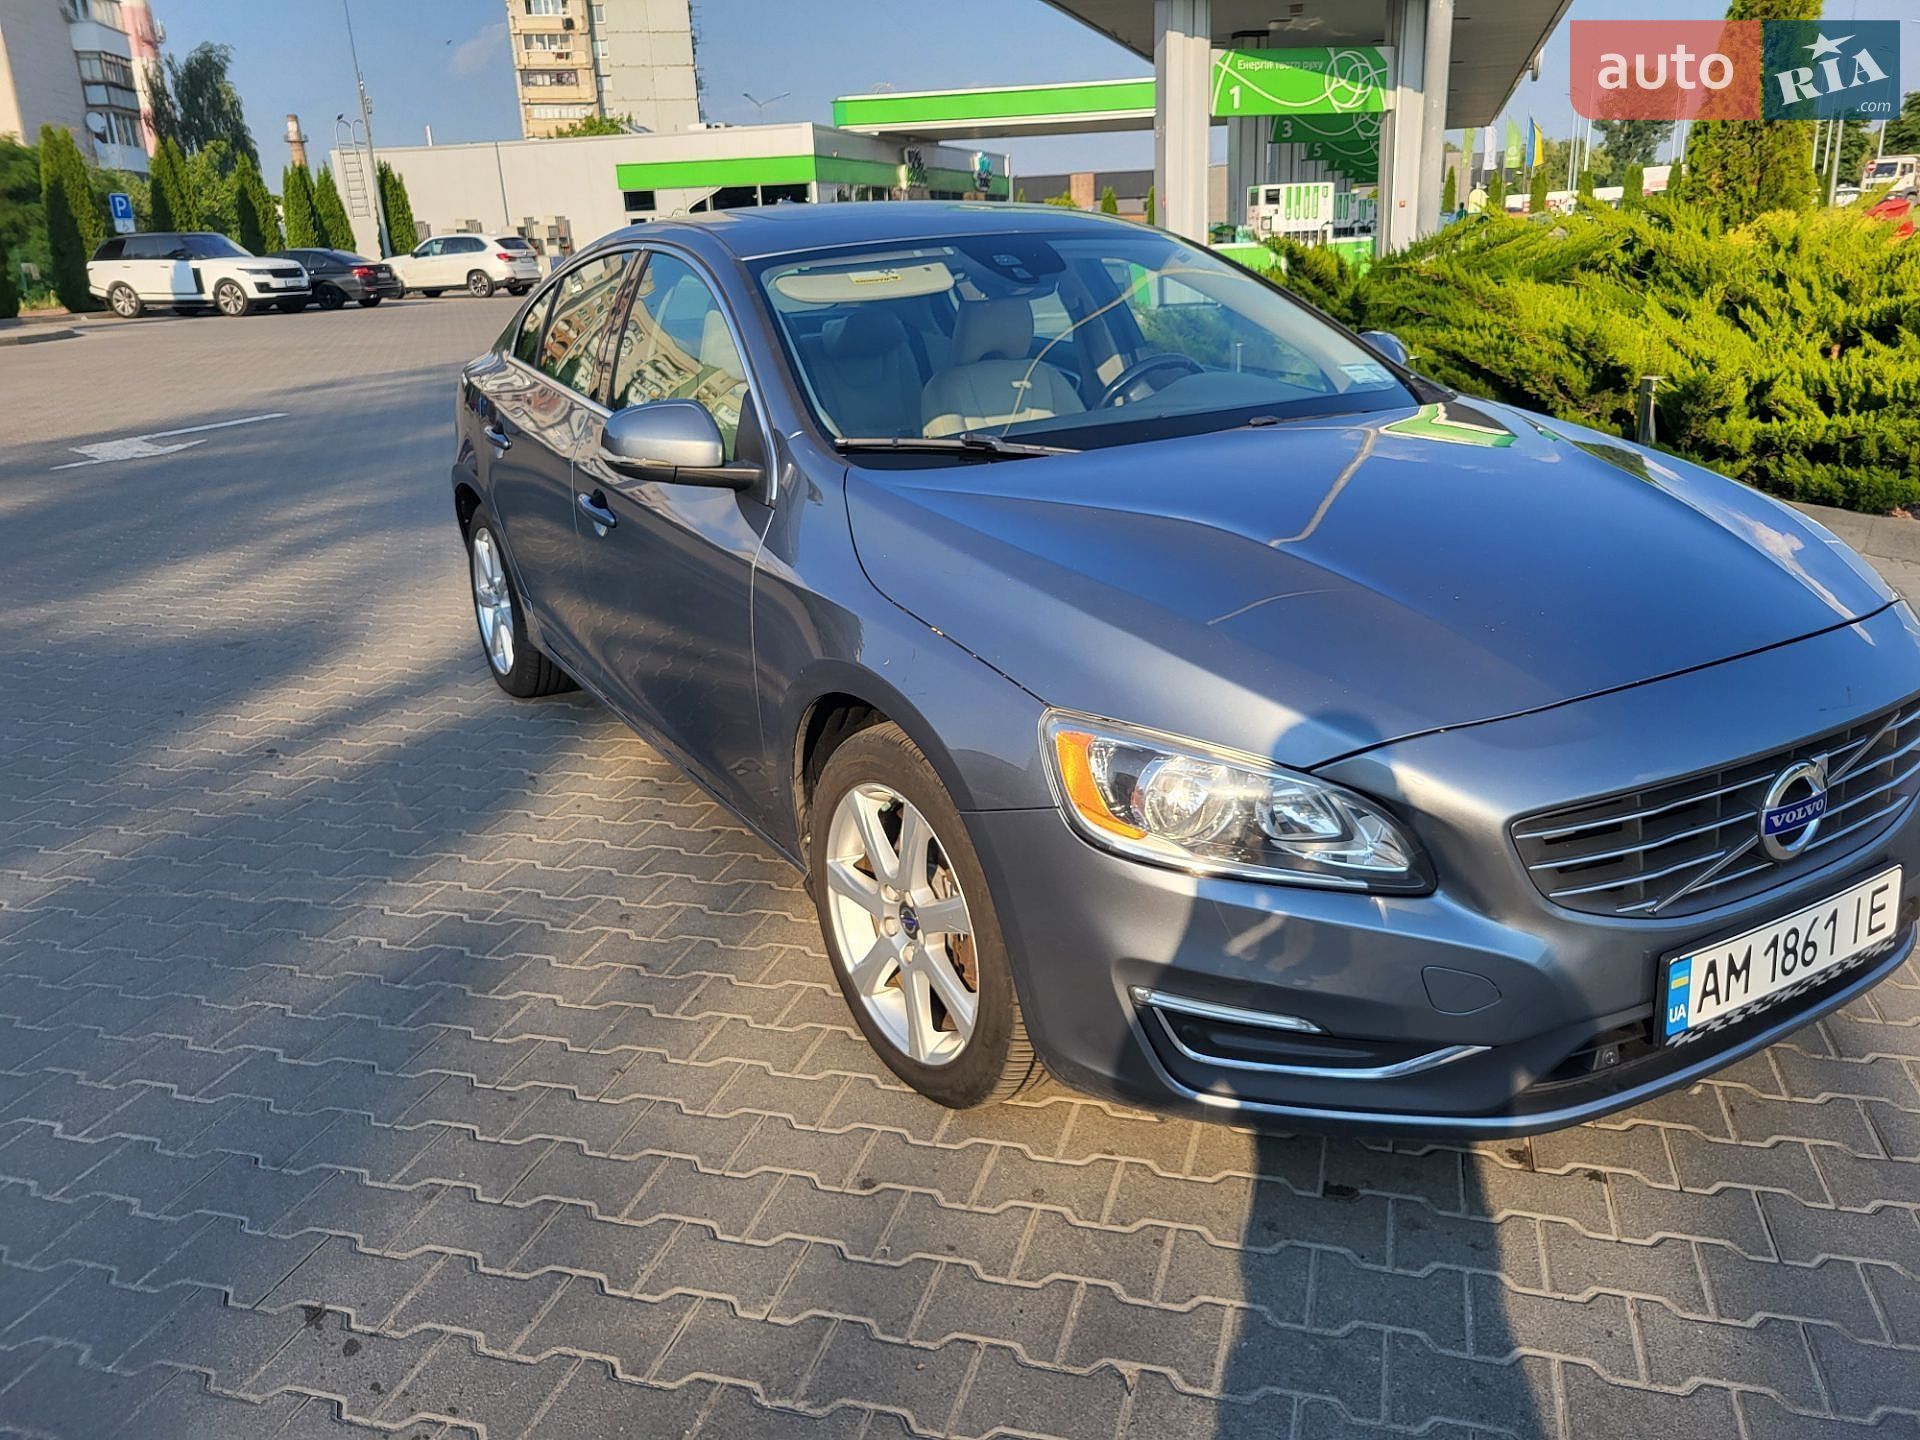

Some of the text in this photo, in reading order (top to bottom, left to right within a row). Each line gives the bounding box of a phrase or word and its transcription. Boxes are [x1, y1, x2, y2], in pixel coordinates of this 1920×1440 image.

[1229, 85, 1240, 109] 1
[1282, 120, 1293, 138] 3
[1313, 142, 1322, 157] 5
[115, 196, 127, 217] P
[1769, 798, 1824, 828] VOLVO
[1696, 883, 1890, 1014] AM 1861 IE
[1668, 1005, 1687, 1023] UA
